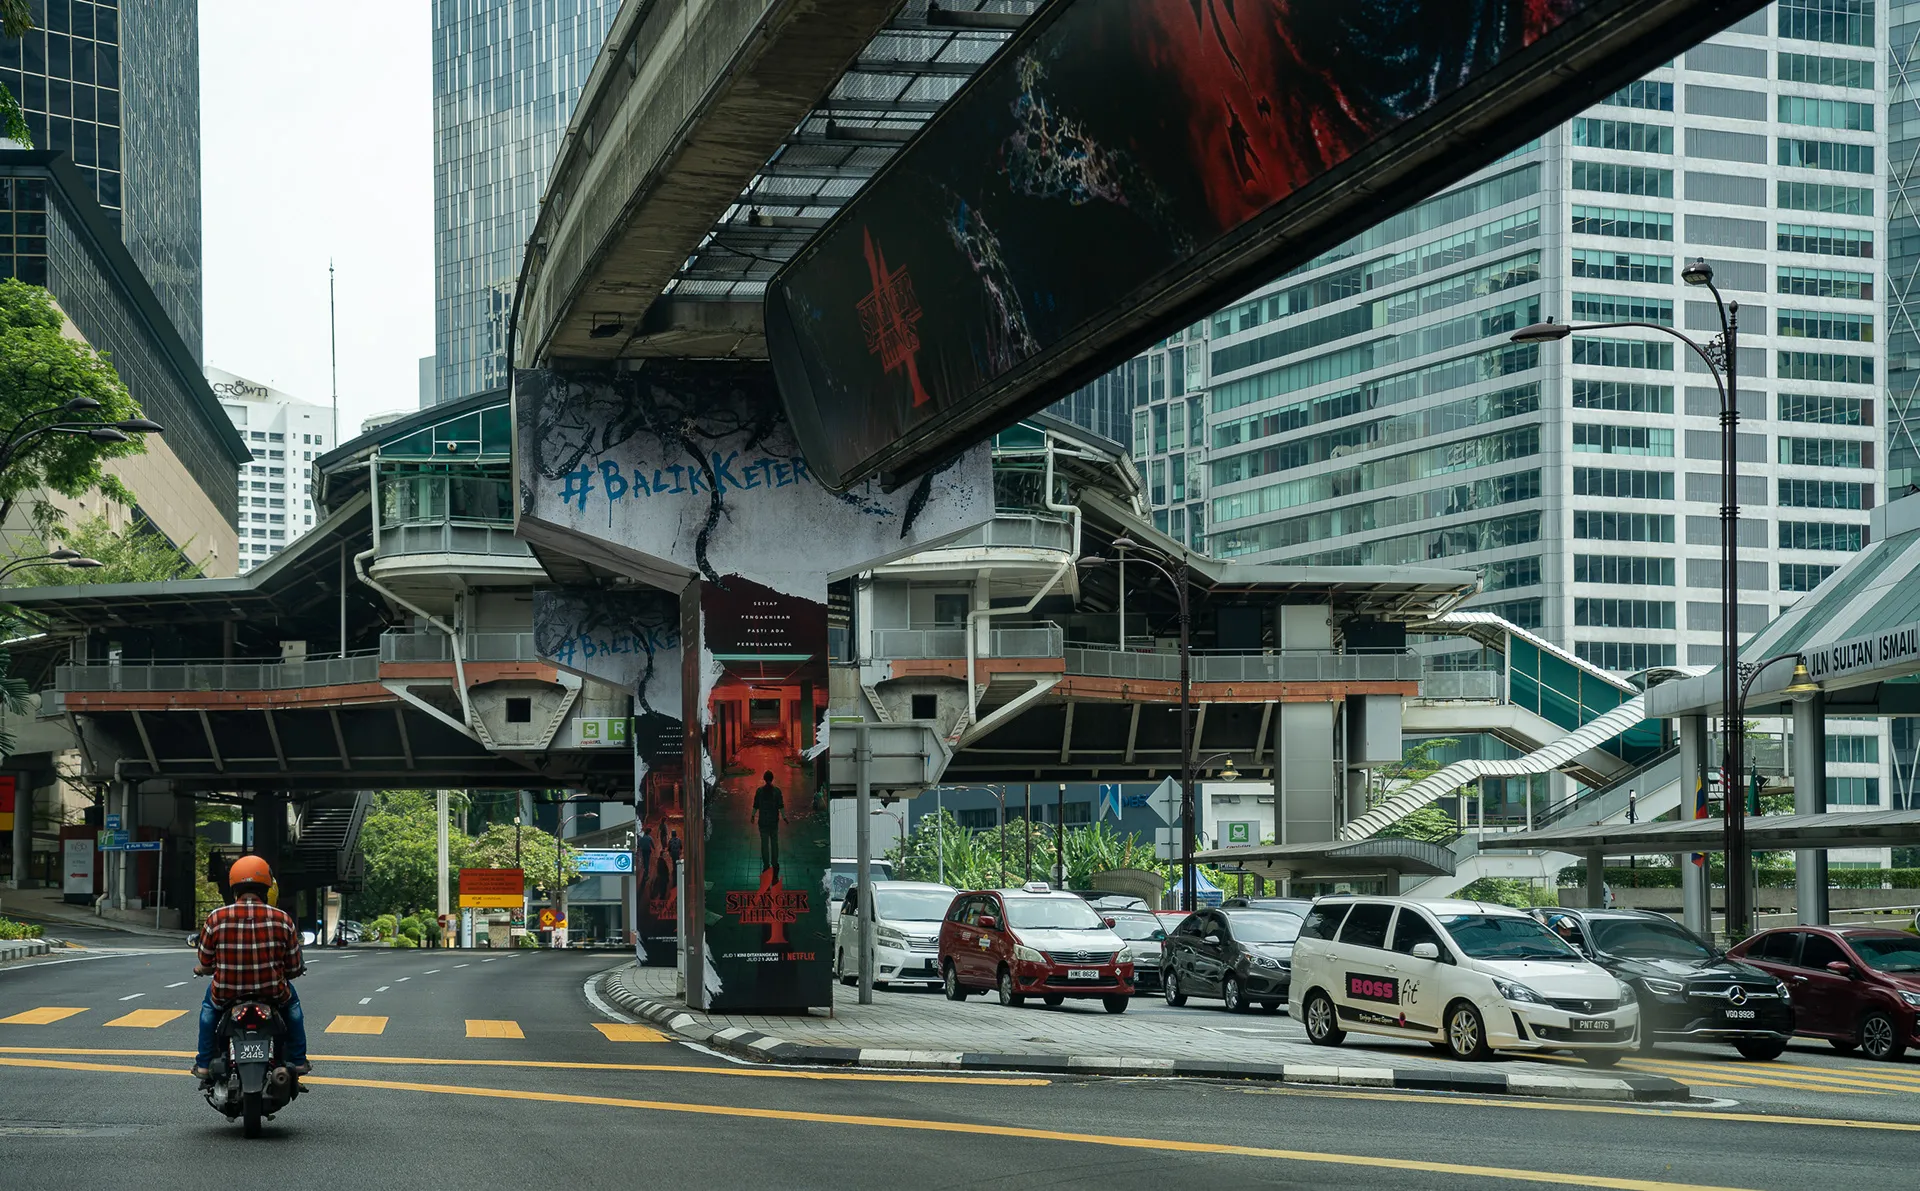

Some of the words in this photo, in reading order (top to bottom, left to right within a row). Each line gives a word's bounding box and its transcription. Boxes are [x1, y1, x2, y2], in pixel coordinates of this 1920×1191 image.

[1811, 650, 1829, 677] JLN
[1833, 640, 1873, 672] SULTAN
[1879, 629, 1917, 661] ISMAIL
[727, 892, 809, 911] STRANGER
[741, 909, 797, 922] THINGS
[787, 952, 815, 960] NETFLIX
[1351, 978, 1393, 998] BOSS
[1401, 979, 1418, 1006] fit
[1738, 1010, 1755, 1019] 9928
[1579, 1021, 1593, 1029] PNT
[1594, 1021, 1610, 1030] 4176
[243, 1044, 261, 1052] WYX
[240, 1051, 265, 1059] 2445
